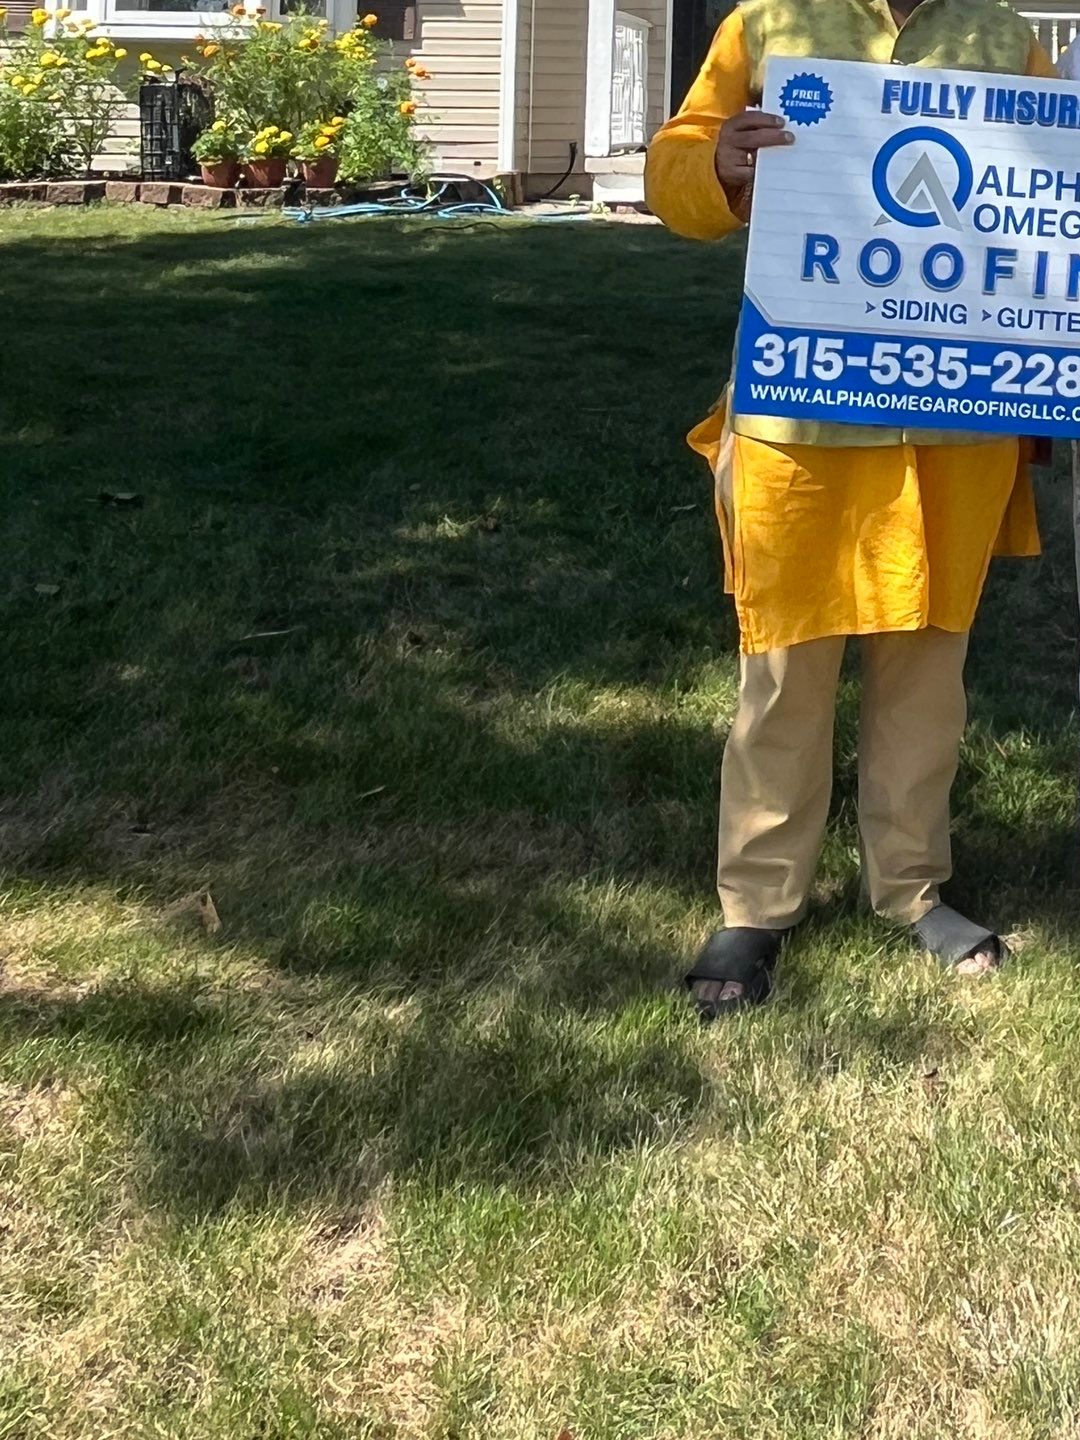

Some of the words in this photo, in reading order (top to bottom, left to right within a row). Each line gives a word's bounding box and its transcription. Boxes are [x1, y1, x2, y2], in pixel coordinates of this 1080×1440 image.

[792, 88, 821, 101] FREE
[880, 78, 977, 120] FULLY
[880, 298, 968, 325] SIDING
